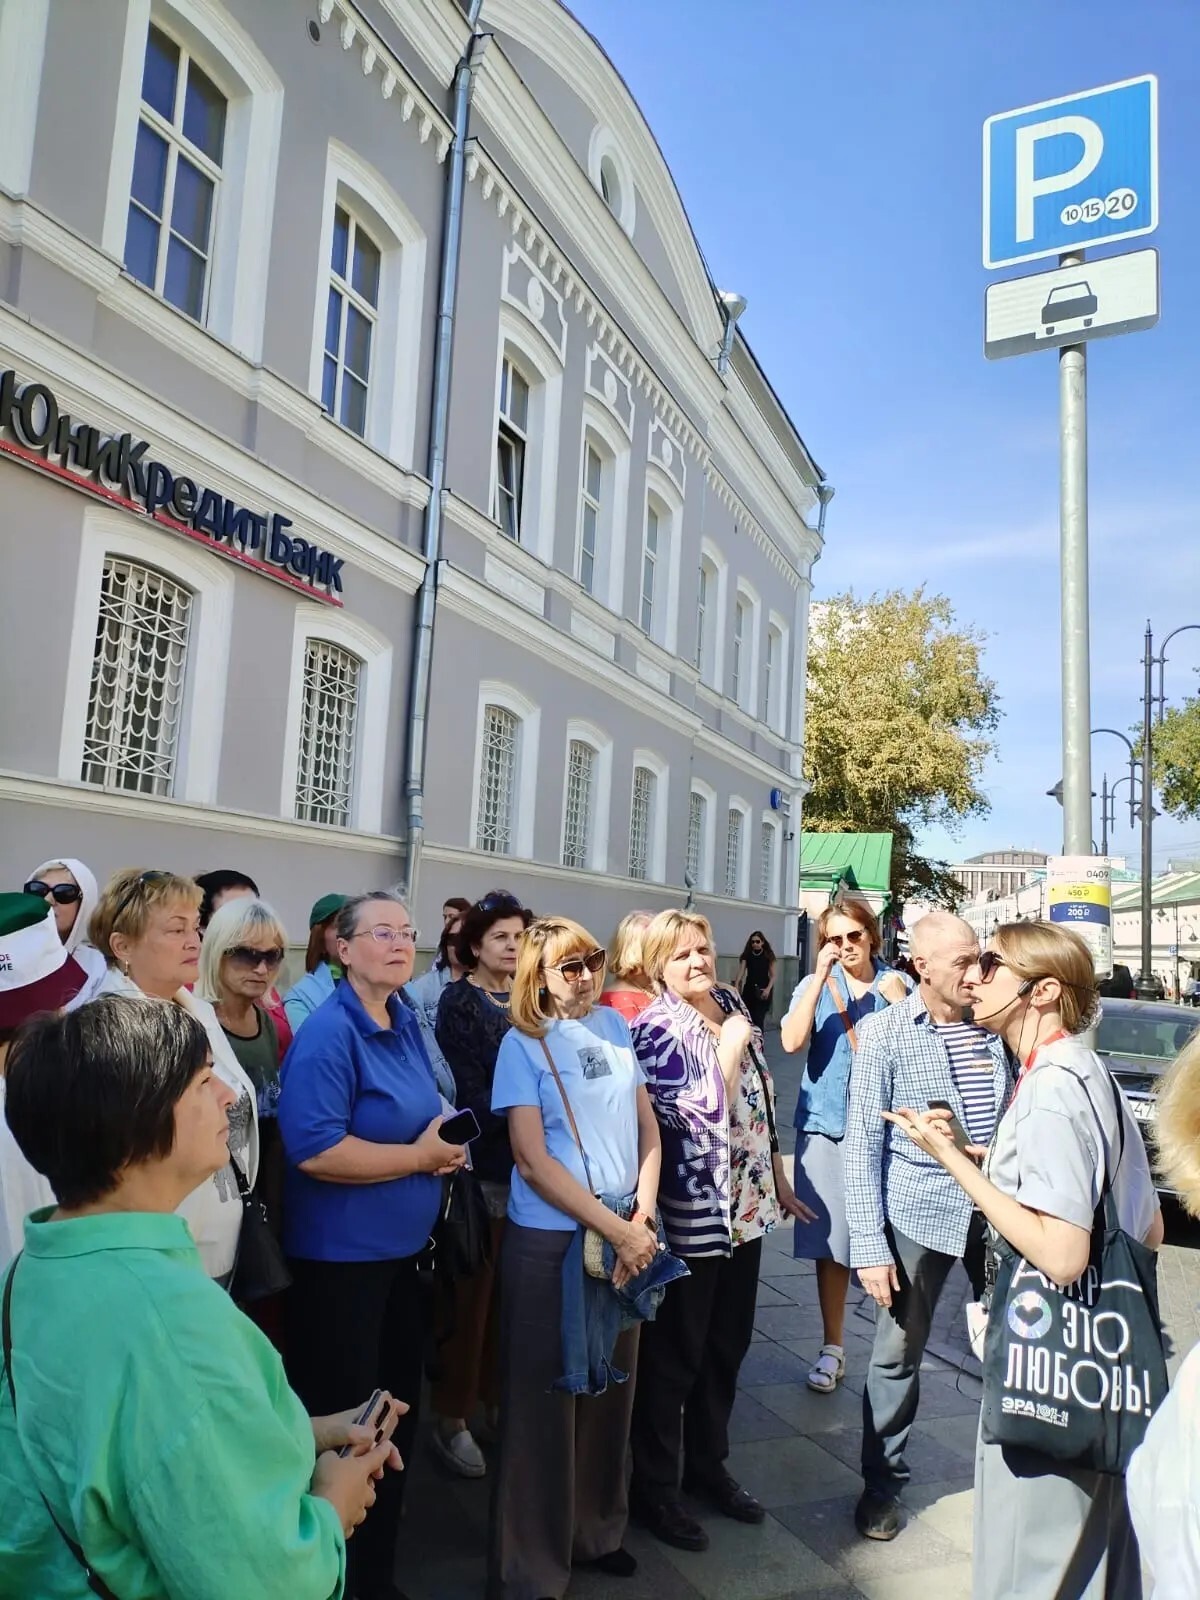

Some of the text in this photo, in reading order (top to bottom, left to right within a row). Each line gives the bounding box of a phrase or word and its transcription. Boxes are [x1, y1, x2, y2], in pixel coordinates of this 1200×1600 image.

[1016, 115, 1104, 243] P
[1065, 193, 1135, 221] 10 15 20
[1067, 908, 1083, 916] 200
[1062, 1302, 1129, 1359] ЭТО
[1004, 1343, 1151, 1417] ЛЮБОВЬ!
[1001, 1396, 1036, 1412] ЭРА
